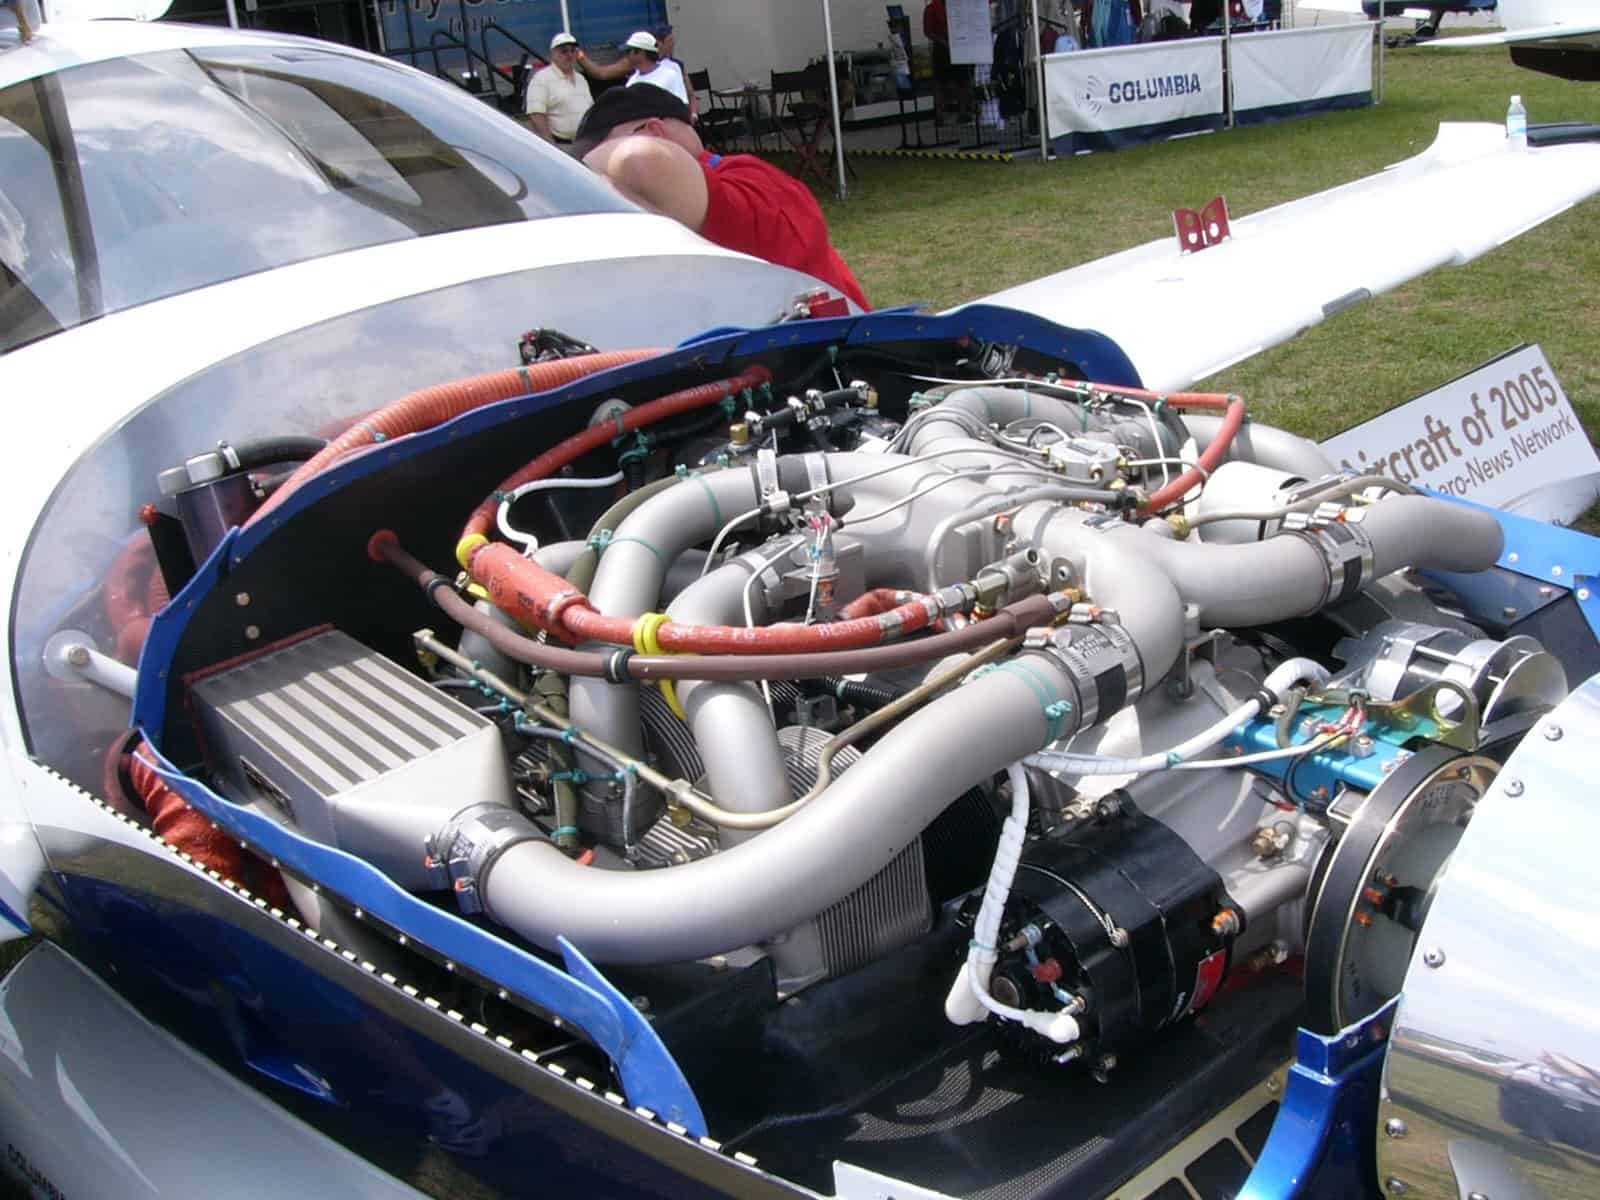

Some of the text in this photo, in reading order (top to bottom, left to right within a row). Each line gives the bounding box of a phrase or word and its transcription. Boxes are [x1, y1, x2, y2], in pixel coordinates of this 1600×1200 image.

[1109, 73, 1200, 104] COLUMBIA
[1340, 366, 1557, 483] rcraft of 2005
[1425, 410, 1575, 497] ero-News Network
